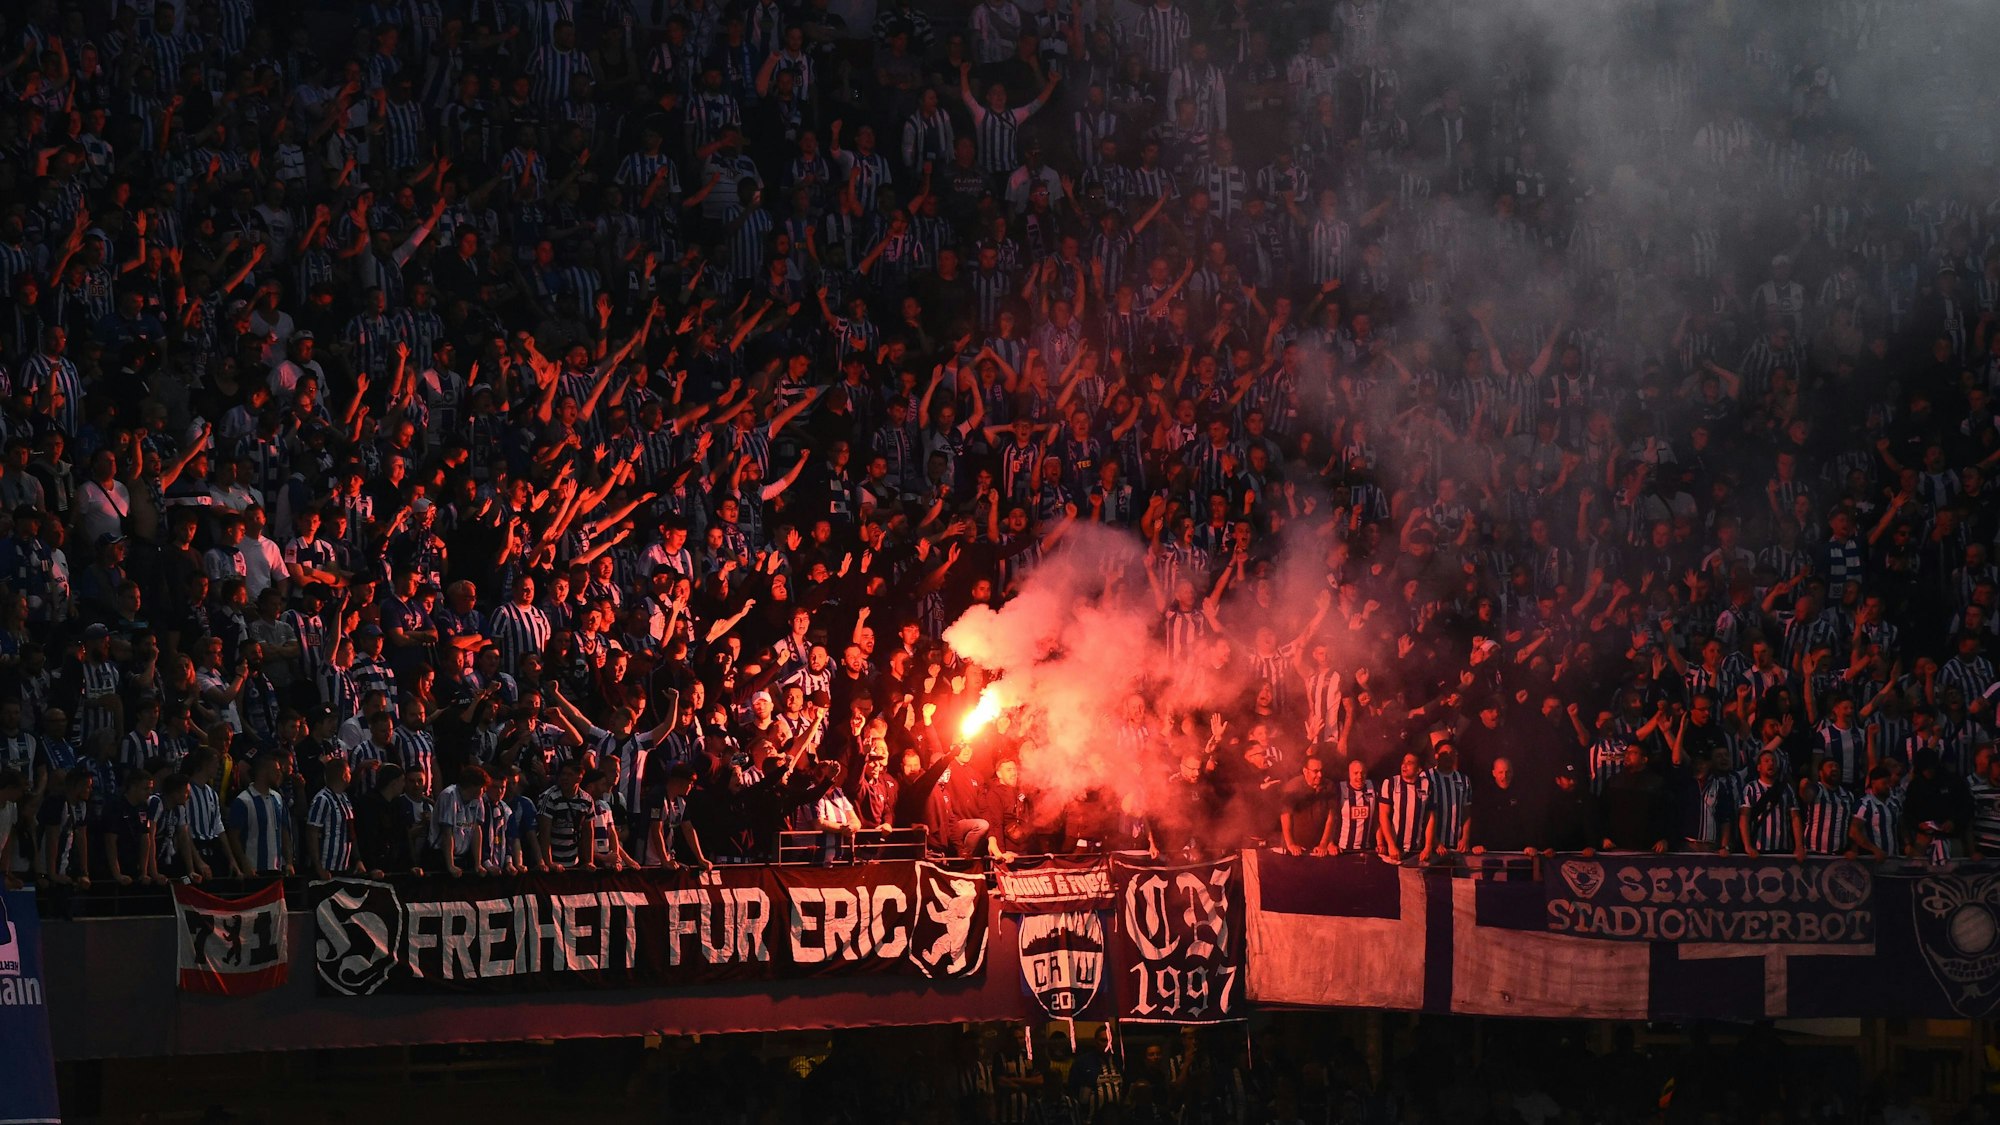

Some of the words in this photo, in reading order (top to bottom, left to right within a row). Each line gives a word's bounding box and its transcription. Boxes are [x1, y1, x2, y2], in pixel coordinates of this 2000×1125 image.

[1353, 807, 1368, 819] DB
[1617, 865, 1822, 904] SEKTION
[405, 891, 649, 979] FREIHEIT
[664, 870, 770, 966] FÜR
[788, 884, 908, 962] ERIC
[1547, 898, 1871, 941] STADIONVERBOT
[0, 976, 42, 1006] ain
[1130, 961, 1237, 1018] 1997
